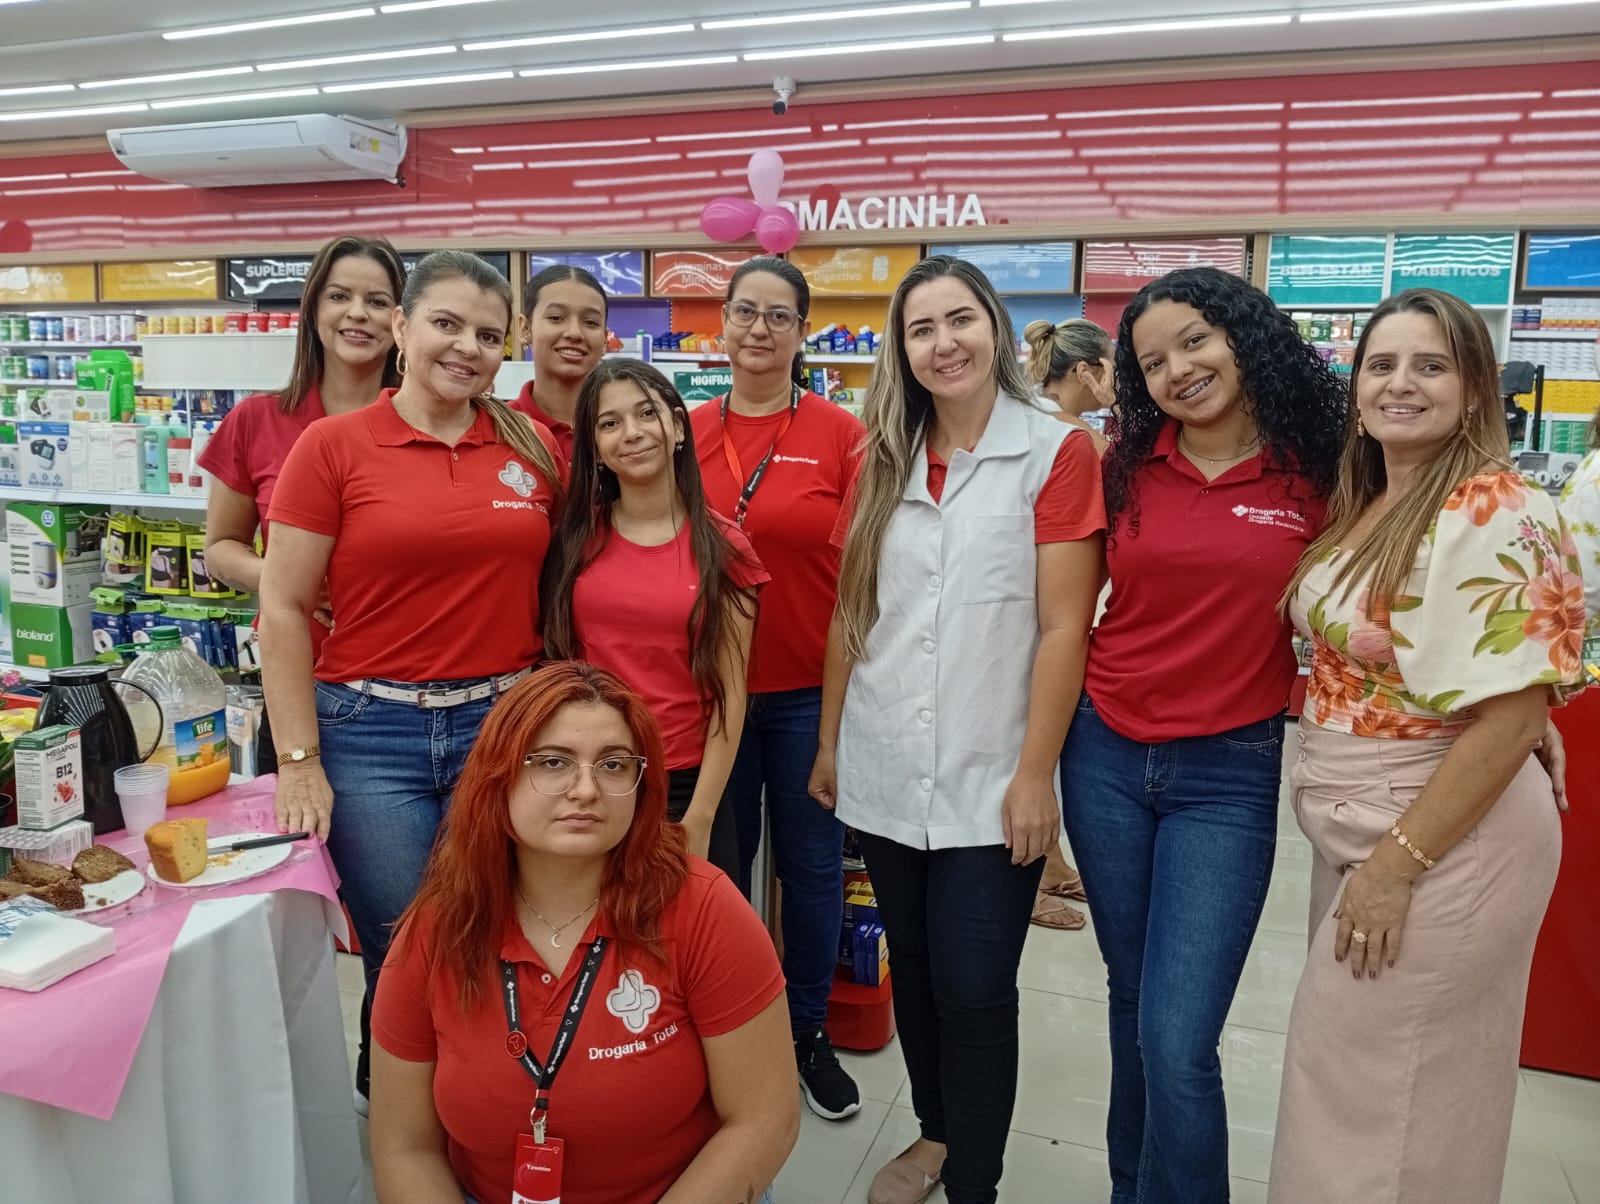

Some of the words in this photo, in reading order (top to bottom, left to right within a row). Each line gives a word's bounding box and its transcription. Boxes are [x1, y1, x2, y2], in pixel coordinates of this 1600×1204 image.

[492, 499, 533, 510] Drogaria
[1249, 506, 1285, 518] Drogaria
[16, 628, 54, 642] bioland
[196, 721, 214, 735] life
[56, 762, 74, 779] B12
[588, 1040, 648, 1061] Drogaria
[652, 1021, 679, 1045] Total
